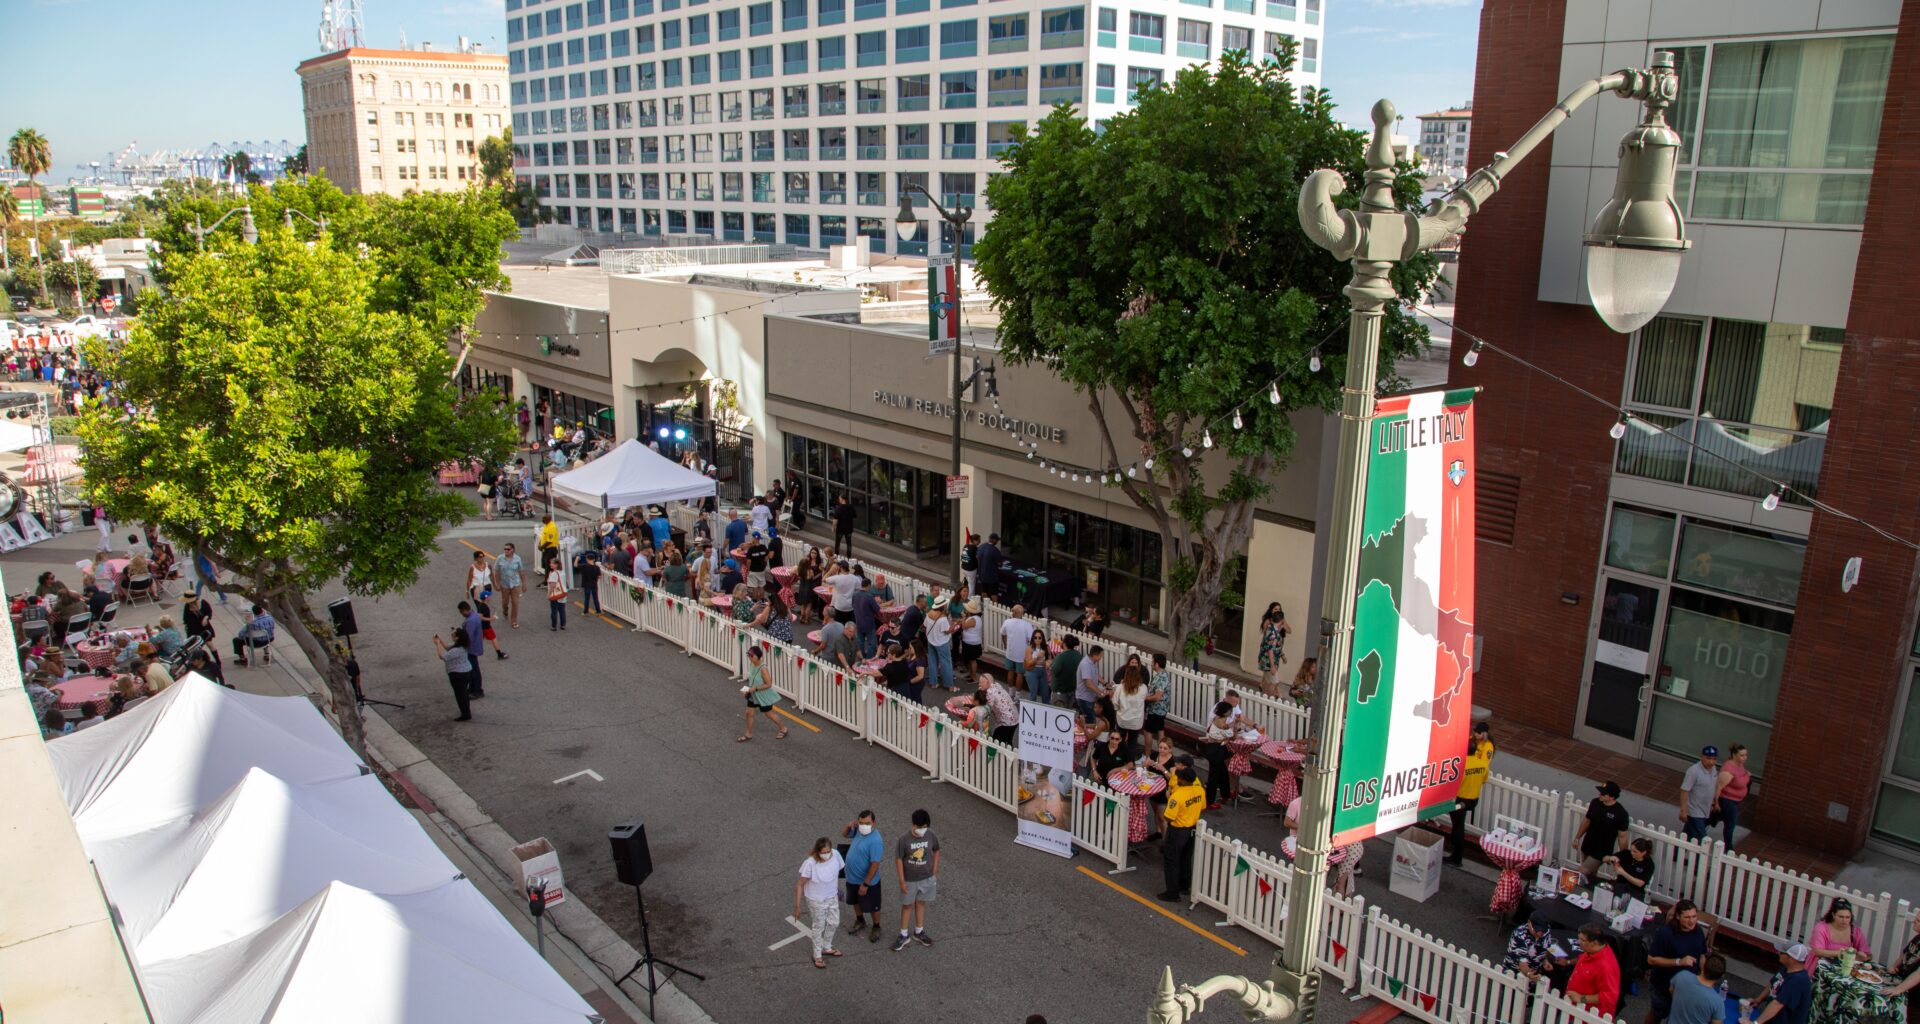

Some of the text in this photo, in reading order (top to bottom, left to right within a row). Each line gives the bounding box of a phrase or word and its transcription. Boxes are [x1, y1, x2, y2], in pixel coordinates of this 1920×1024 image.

[873, 390, 1062, 443] PALM REALY BOUTIQUE
[1378, 410, 1468, 455] LITTLE ITALY
[1694, 636, 1770, 680] HOLO
[1022, 705, 1072, 733] NIO
[1021, 730, 1071, 746] COCKTAILS
[1341, 756, 1462, 811] LOS ANGELES
[1465, 766, 1486, 776] SECURITY
[1185, 795, 1202, 807] SECURITY
